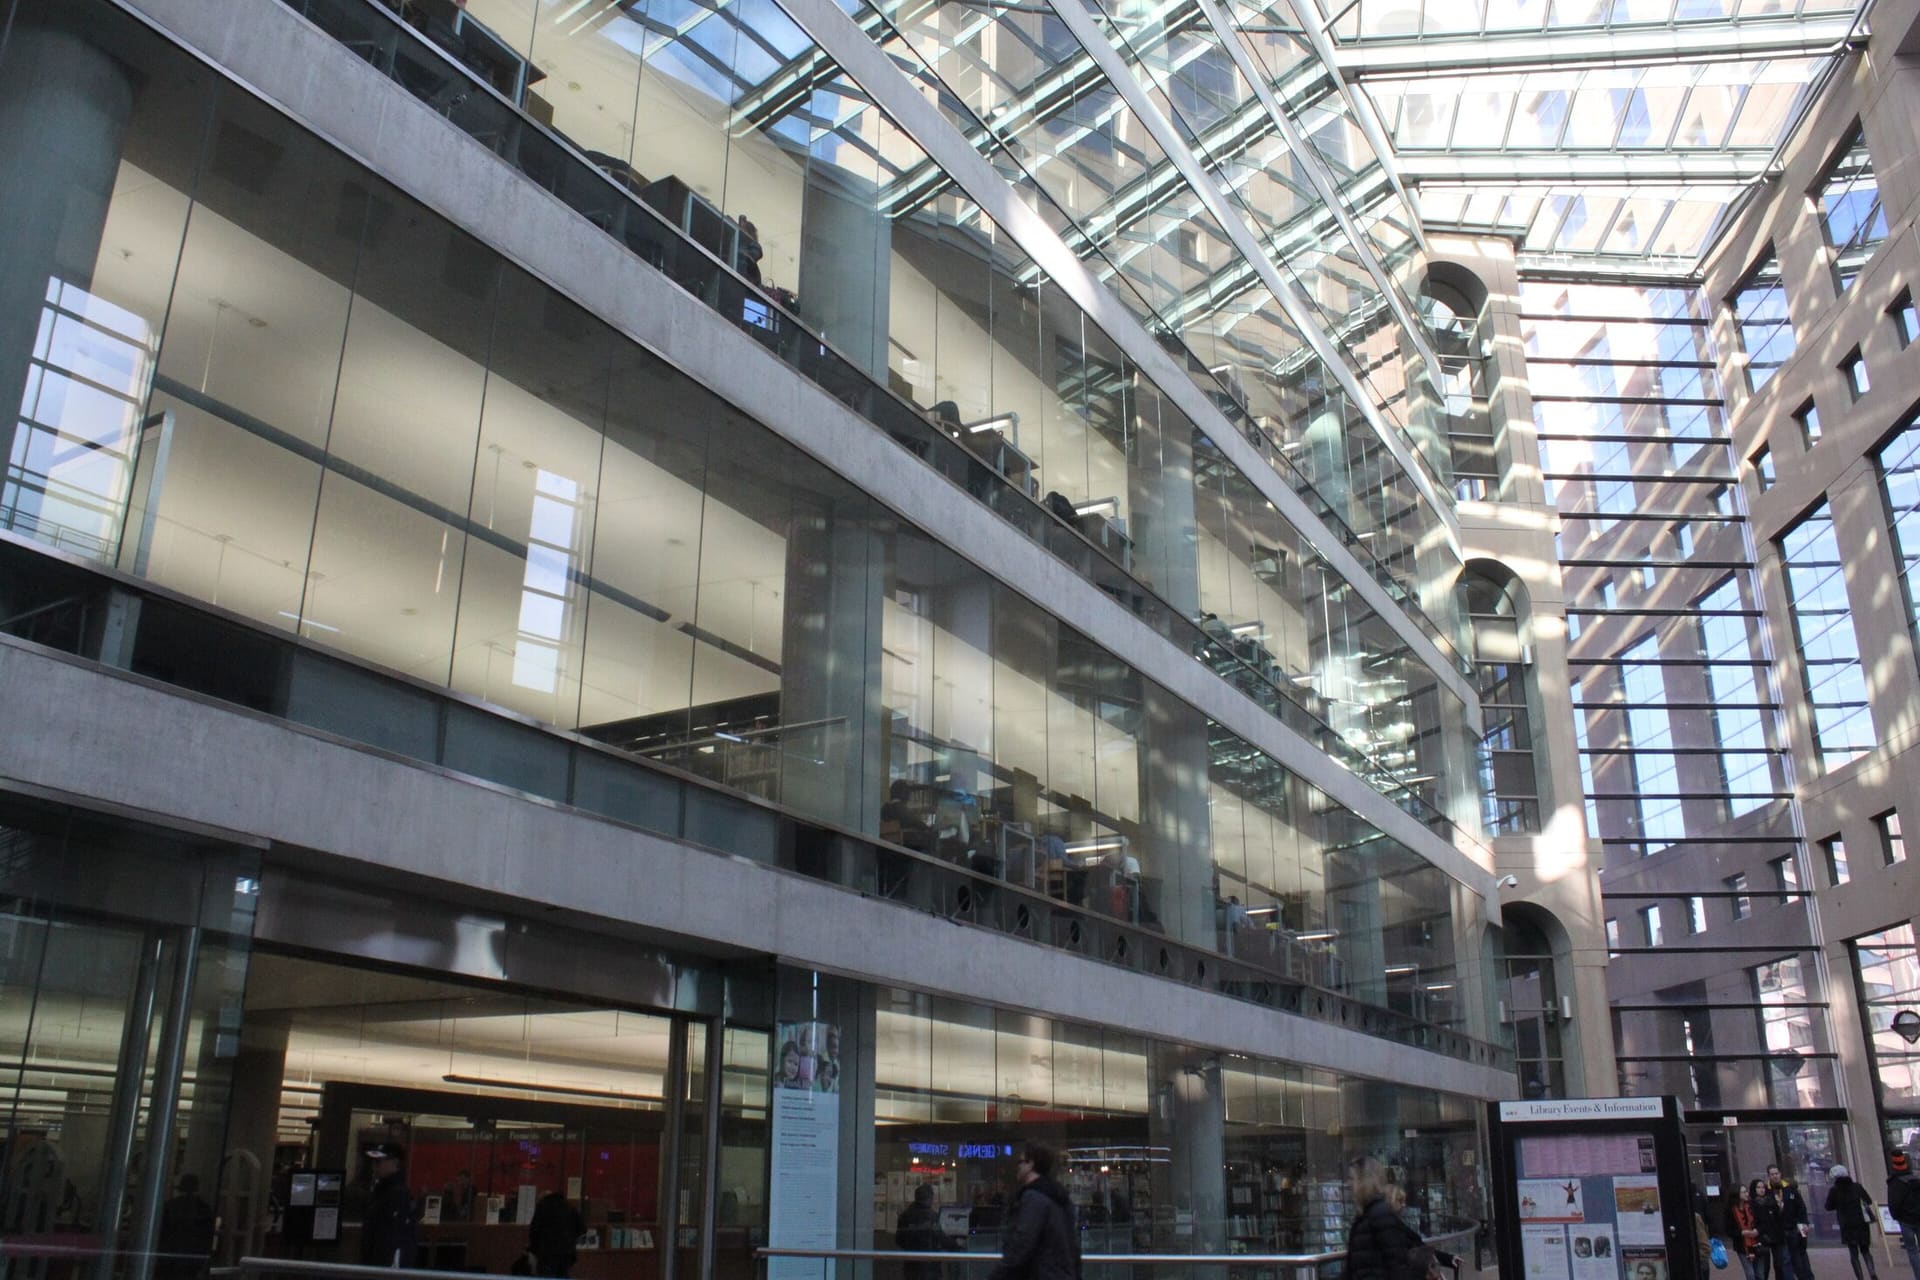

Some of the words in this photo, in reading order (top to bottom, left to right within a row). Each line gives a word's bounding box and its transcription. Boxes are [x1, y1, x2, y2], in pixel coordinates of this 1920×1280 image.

[1530, 1104, 1562, 1116] Library
[1563, 1104, 1592, 1114] Events
[1594, 1103, 1601, 1112] &
[1604, 1102, 1656, 1112] Information
